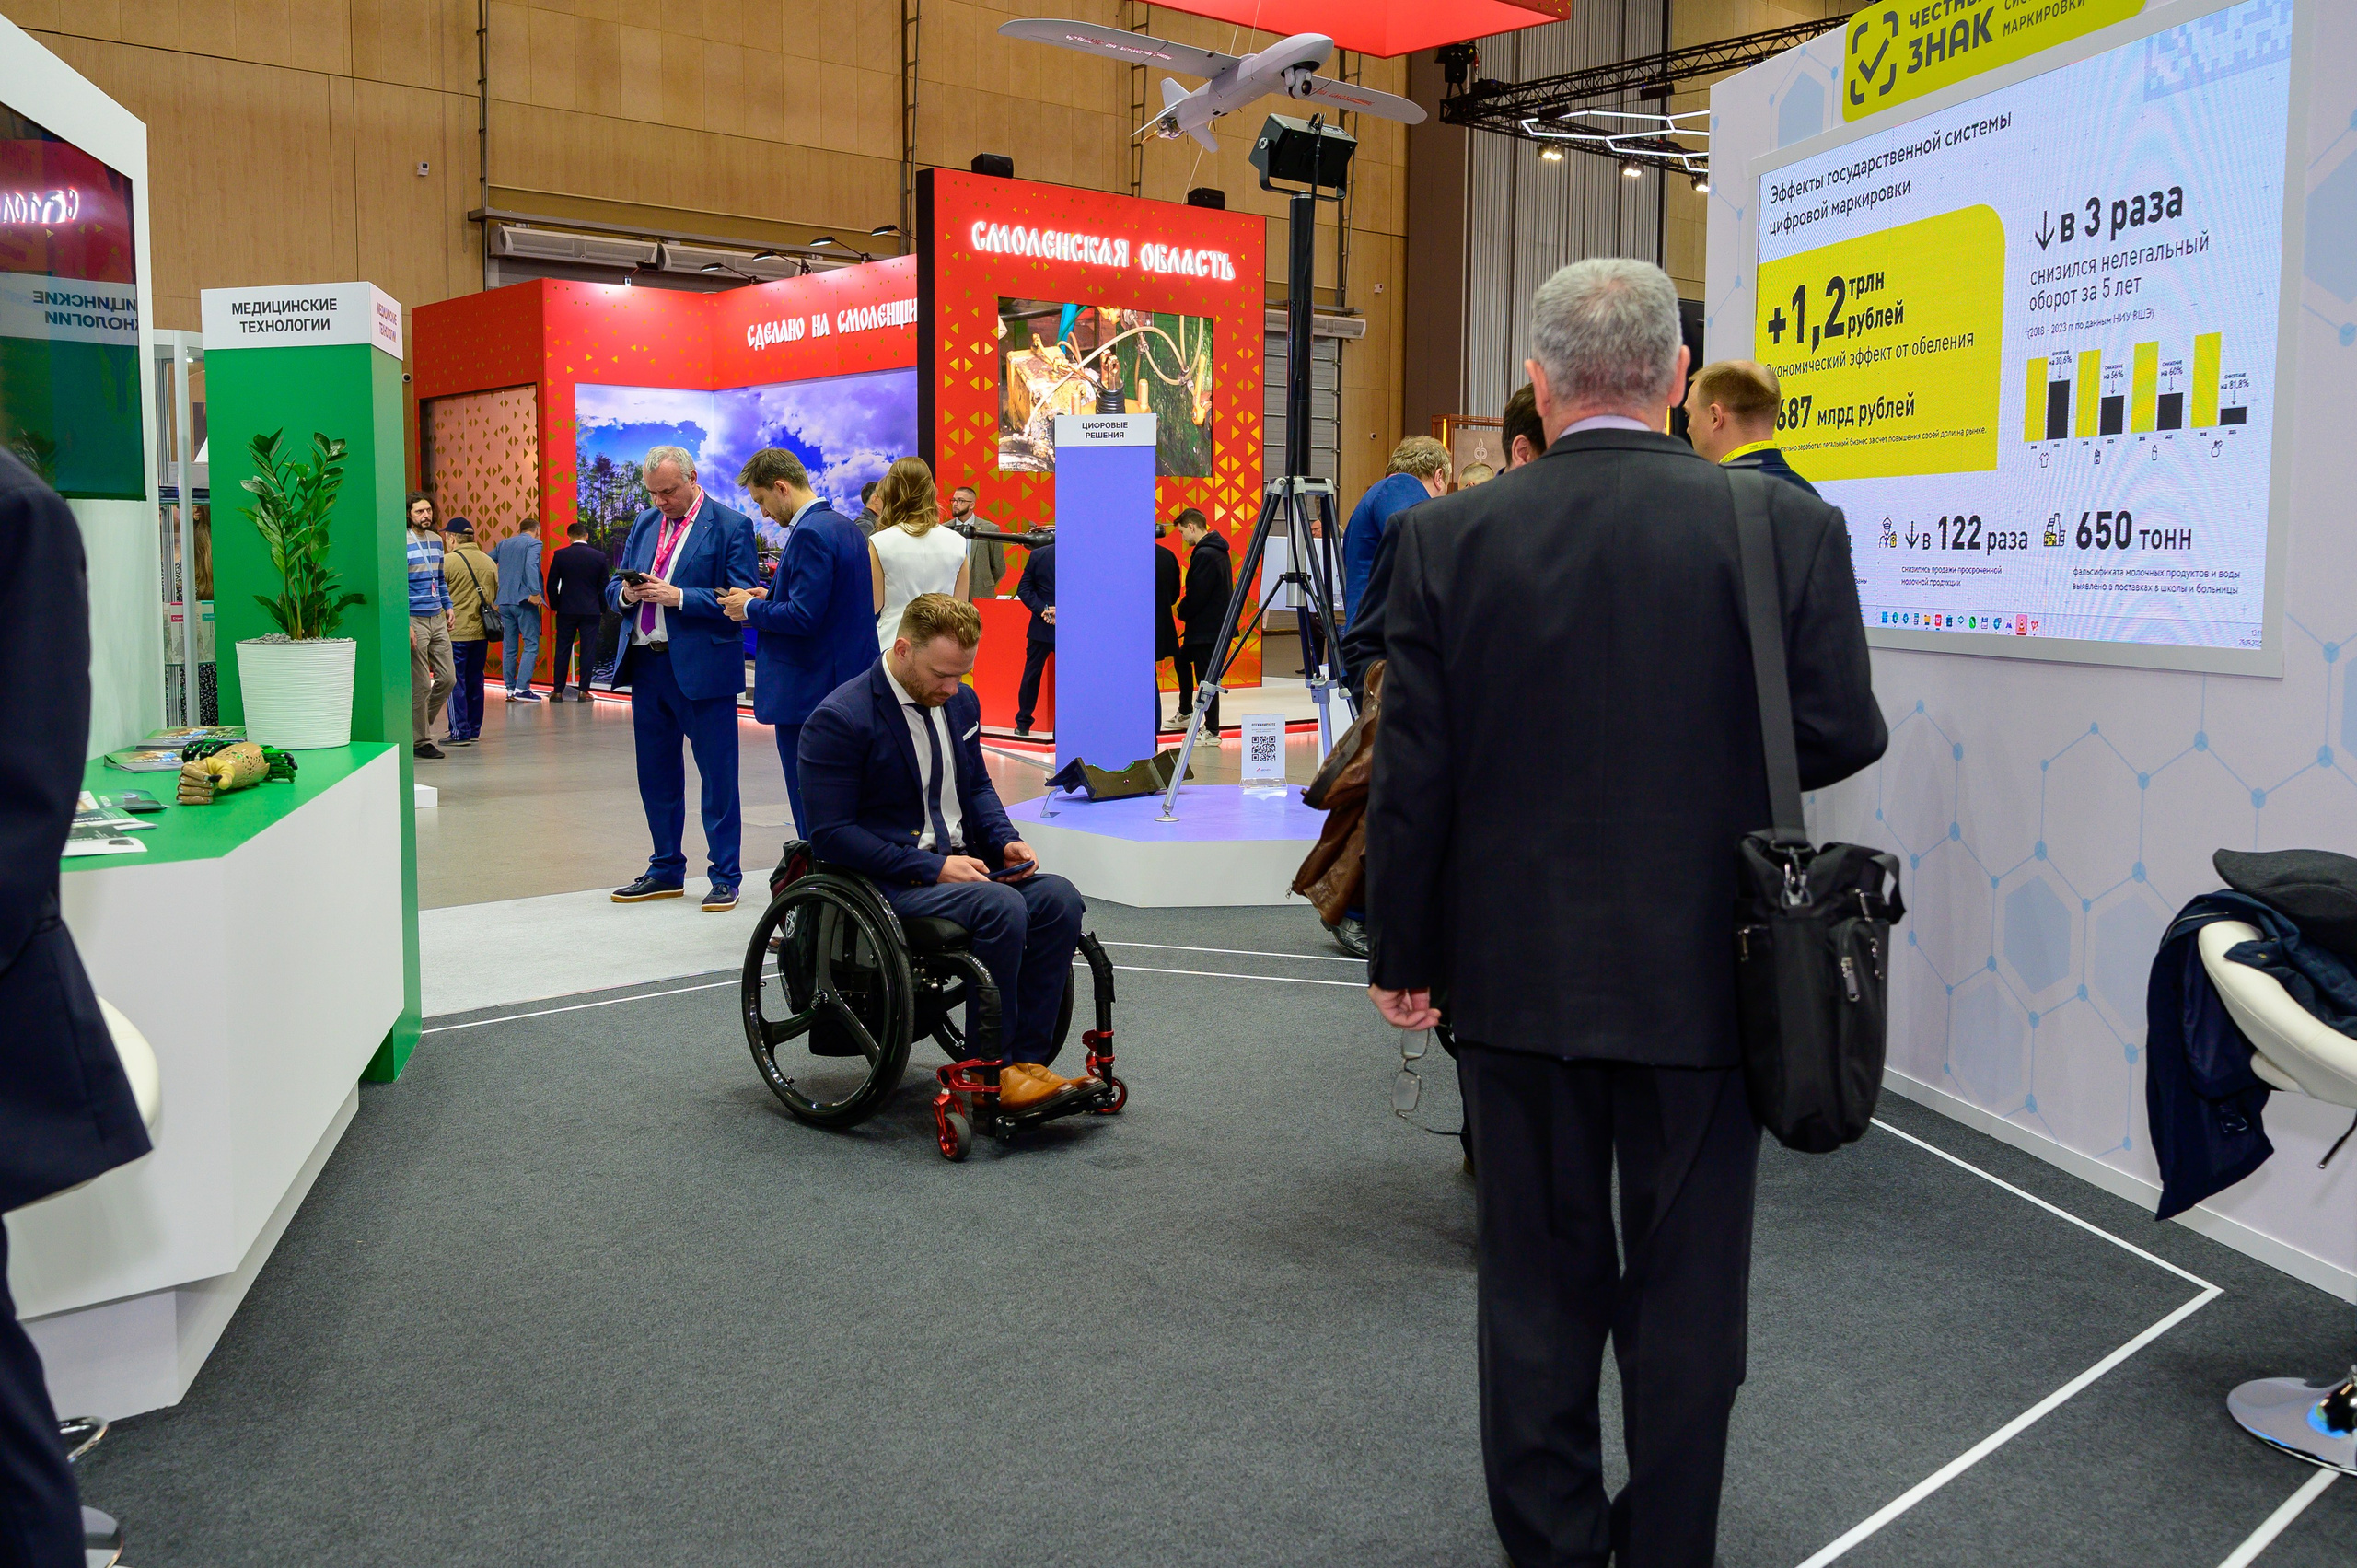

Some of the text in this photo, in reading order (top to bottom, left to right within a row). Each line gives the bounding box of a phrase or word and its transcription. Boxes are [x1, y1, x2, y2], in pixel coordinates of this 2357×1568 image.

[1907, 6, 1995, 74] ЗНАК
[1771, 111, 2012, 205] Эффекты государственной системы
[1769, 180, 1911, 235] цифровой маркировки
[2060, 186, 2183, 243] в 3 раза
[971, 220, 1237, 281] СМОЛЕНСКАЯ ОБЛАСТЬ
[2030, 229, 2210, 285] снизился нелегальный
[1848, 271, 1885, 299] трлн
[2029, 277, 2142, 312] оборот за 5 лет
[232, 298, 338, 317] МЕДИЦИНСКИЕ
[239, 318, 331, 333] ТЕХНОЛОГИИ
[1768, 275, 1847, 355] +1,2
[1847, 299, 1904, 339] рублей
[2051, 322, 2068, 334] 2023
[2074, 321, 2084, 330] по
[2084, 318, 2112, 330] данным
[2113, 311, 2131, 324] НИУ
[747, 317, 806, 351] СДЕЛАНО
[811, 313, 830, 339] НА
[1849, 343, 1892, 371] эффект
[1895, 342, 1909, 358] от
[1911, 332, 1974, 356] обеления
[1082, 422, 1128, 430] ЦИФРОВЫЕ
[1776, 391, 1915, 432] 687 млрд рублей
[1085, 431, 1125, 439] РЕШЕНИЯ
[1850, 436, 1868, 447] бизнес
[1888, 433, 1921, 442] повышения
[1922, 429, 1939, 440] своей
[1940, 430, 1956, 438] доли
[1956, 428, 1965, 436] на
[1922, 514, 2028, 556] в 122 раза
[2075, 510, 2192, 550] 650 тонн
[1901, 577, 1961, 587] молочной продукции
[1931, 566, 1956, 575] продажи
[1957, 565, 2003, 575] просроченной
[2073, 565, 2124, 578] фальсификата
[2165, 569, 2210, 579] продуктов
[2218, 570, 2241, 579] воды
[2114, 584, 2153, 592] поставках
[2160, 585, 2187, 593] школы
[2196, 583, 2238, 596] больницы
